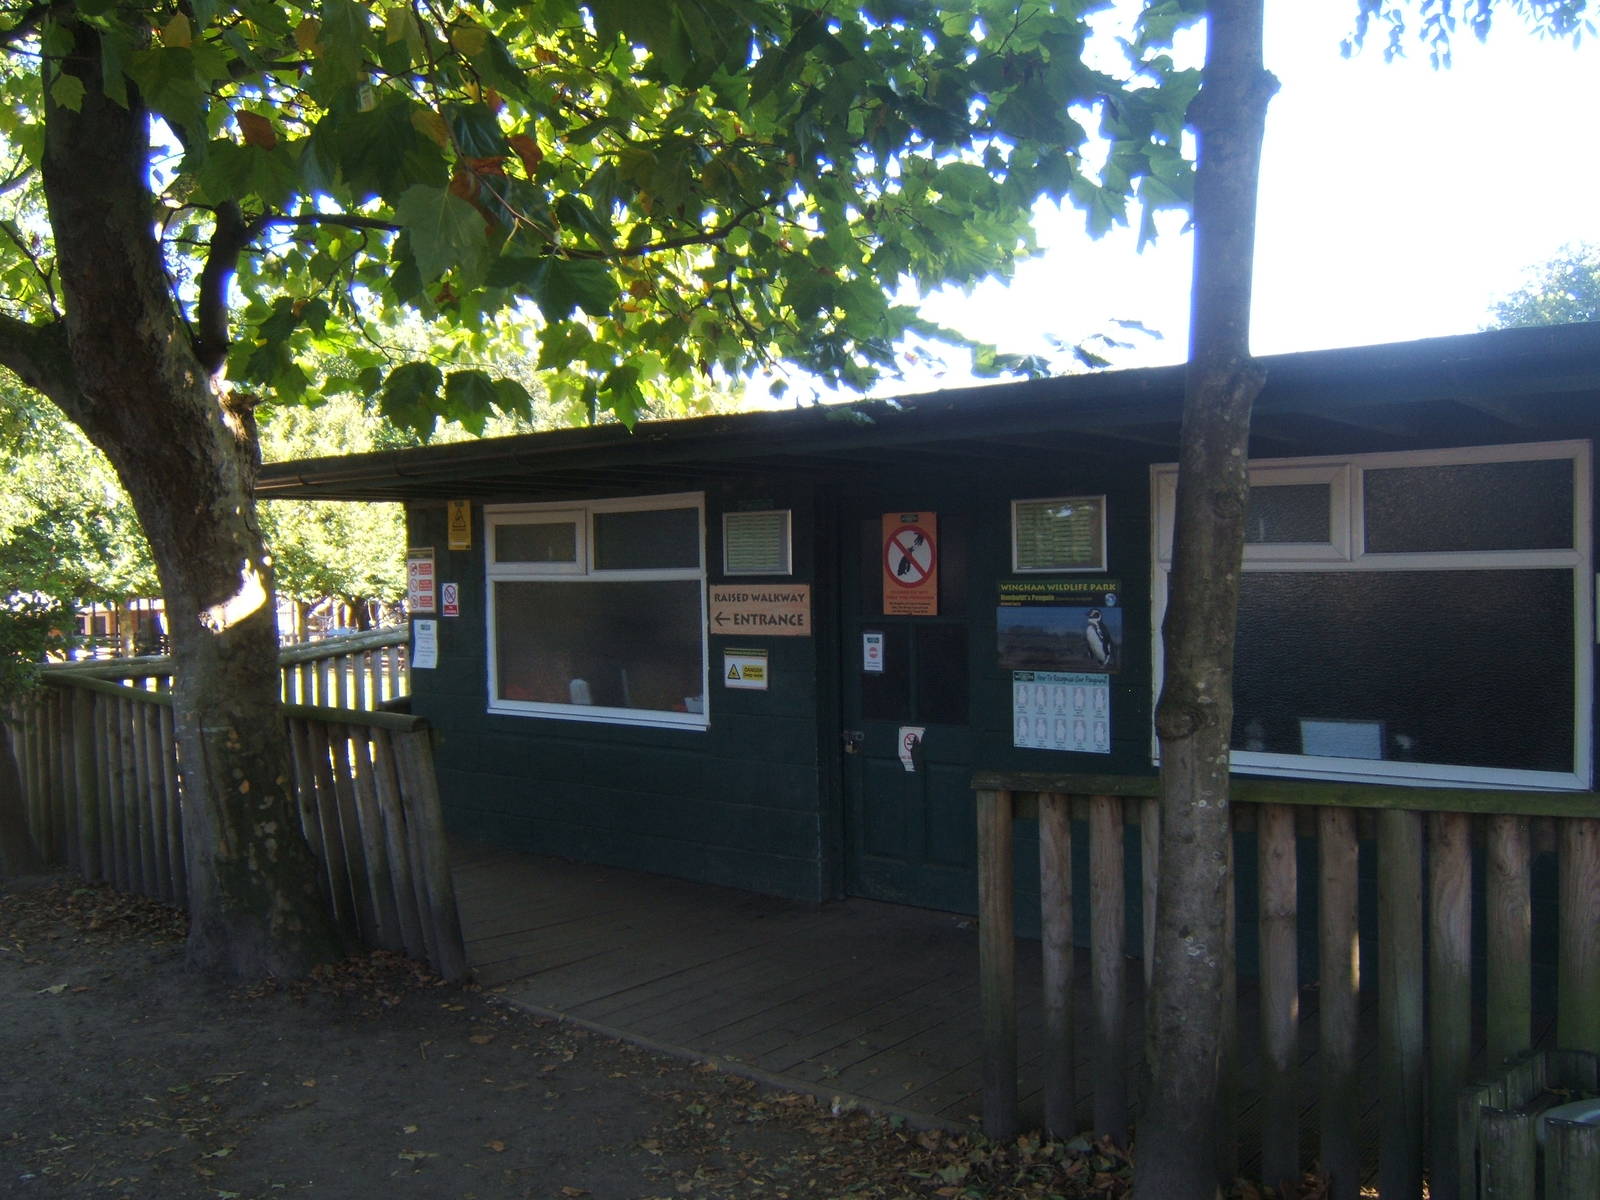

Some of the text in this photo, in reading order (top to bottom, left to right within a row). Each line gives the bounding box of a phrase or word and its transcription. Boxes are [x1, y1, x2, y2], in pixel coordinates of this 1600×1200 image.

[1000, 583, 1117, 592] WINGHAM WILDLIFE PARK
[714, 593, 806, 602] RAISED WALKWAY
[733, 613, 804, 626] ENTRANCE
